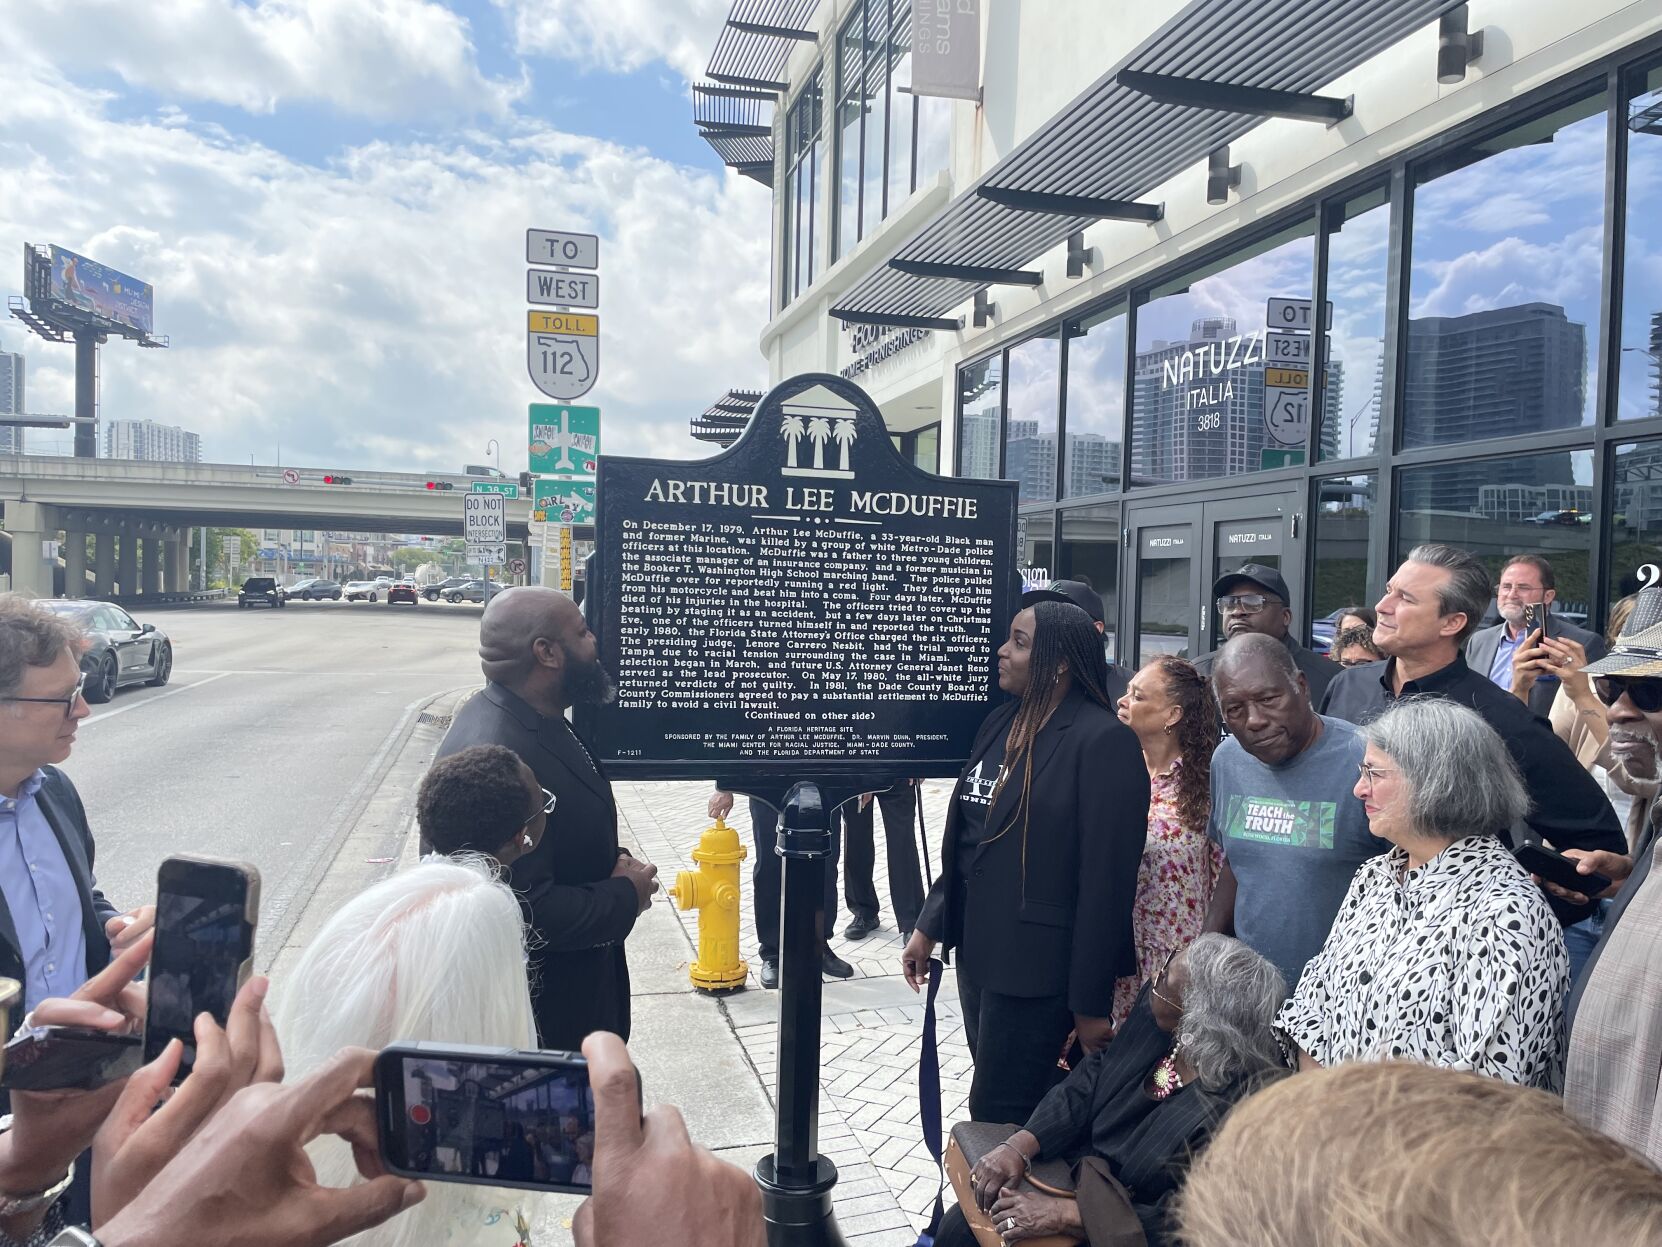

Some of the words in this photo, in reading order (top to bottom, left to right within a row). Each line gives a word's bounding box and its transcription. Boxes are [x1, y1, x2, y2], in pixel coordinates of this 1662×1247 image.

[545, 238, 578, 260] TO
[538, 275, 589, 301] WEST
[543, 316, 585, 332] TOLL
[542, 350, 574, 376] 112
[1162, 329, 1267, 389] NATUZZI
[1187, 380, 1234, 410] ITALIA
[1197, 412, 1220, 432] 3818
[504, 487, 513, 495] ST
[644, 478, 769, 507] ARTHUR
[786, 486, 834, 511] LEE
[850, 490, 977, 518] MCDUFFIE
[466, 498, 480, 510] DO
[483, 499, 502, 510] NOT
[469, 515, 500, 526] BLOCK
[1149, 538, 1171, 547] NATUZZI
[1228, 533, 1256, 543] NATUZZI
[1258, 533, 1272, 541] ITALIA
[622, 542, 664, 551] officers
[683, 544, 702, 552] this
[706, 545, 750, 554] location.
[760, 548, 806, 557] McDuffie
[810, 549, 828, 558] was
[842, 552, 872, 560] father
[891, 554, 917, 562] three
[922, 556, 950, 565] young
[644, 563, 680, 572] Booker
[684, 565, 694, 573] T.
[698, 566, 755, 576] Washington
[760, 568, 783, 578] High
[786, 569, 819, 578] School
[823, 570, 867, 581] marching
[872, 573, 896, 581] band.
[910, 574, 928, 582] The
[932, 576, 960, 584] police
[964, 577, 992, 585] pulled
[622, 573, 670, 582] McDuffie
[705, 576, 720, 584] for
[726, 578, 780, 587] reportedly
[785, 580, 823, 590] running
[840, 582, 856, 590] red
[862, 582, 888, 592] light.
[903, 584, 927, 593] They
[933, 584, 971, 595] dragged
[621, 594, 645, 602] died
[666, 596, 680, 604] his
[686, 596, 725, 606] injuries
[730, 598, 740, 606] in
[765, 600, 807, 609] hospital.
[822, 601, 841, 609] The
[846, 602, 884, 610] officers
[917, 604, 926, 612] to
[961, 607, 972, 615] up
[976, 606, 991, 614] the
[620, 647, 654, 656] Tampa
[662, 648, 681, 656] due
[688, 647, 698, 656] to
[705, 648, 736, 657] racial
[742, 650, 778, 658] tension
[785, 652, 844, 661] surrounding
[851, 652, 867, 660] the
[968, 654, 989, 663] Jury
[619, 689, 656, 698] County
[661, 690, 734, 698] Commissioners
[739, 691, 773, 700] agreed
[791, 693, 809, 701] pay
[822, 692, 873, 700] substantial
[618, 700, 652, 709] family
[657, 700, 668, 708] to
[672, 700, 698, 708] avoid
[714, 700, 736, 708] civil
[740, 700, 779, 709] lawsuit.
[745, 711, 800, 719] (Continued
[822, 712, 848, 720] other
[852, 712, 875, 720] side)
[1248, 804, 1283, 818] TEACH
[1245, 816, 1293, 834] TRUTH
